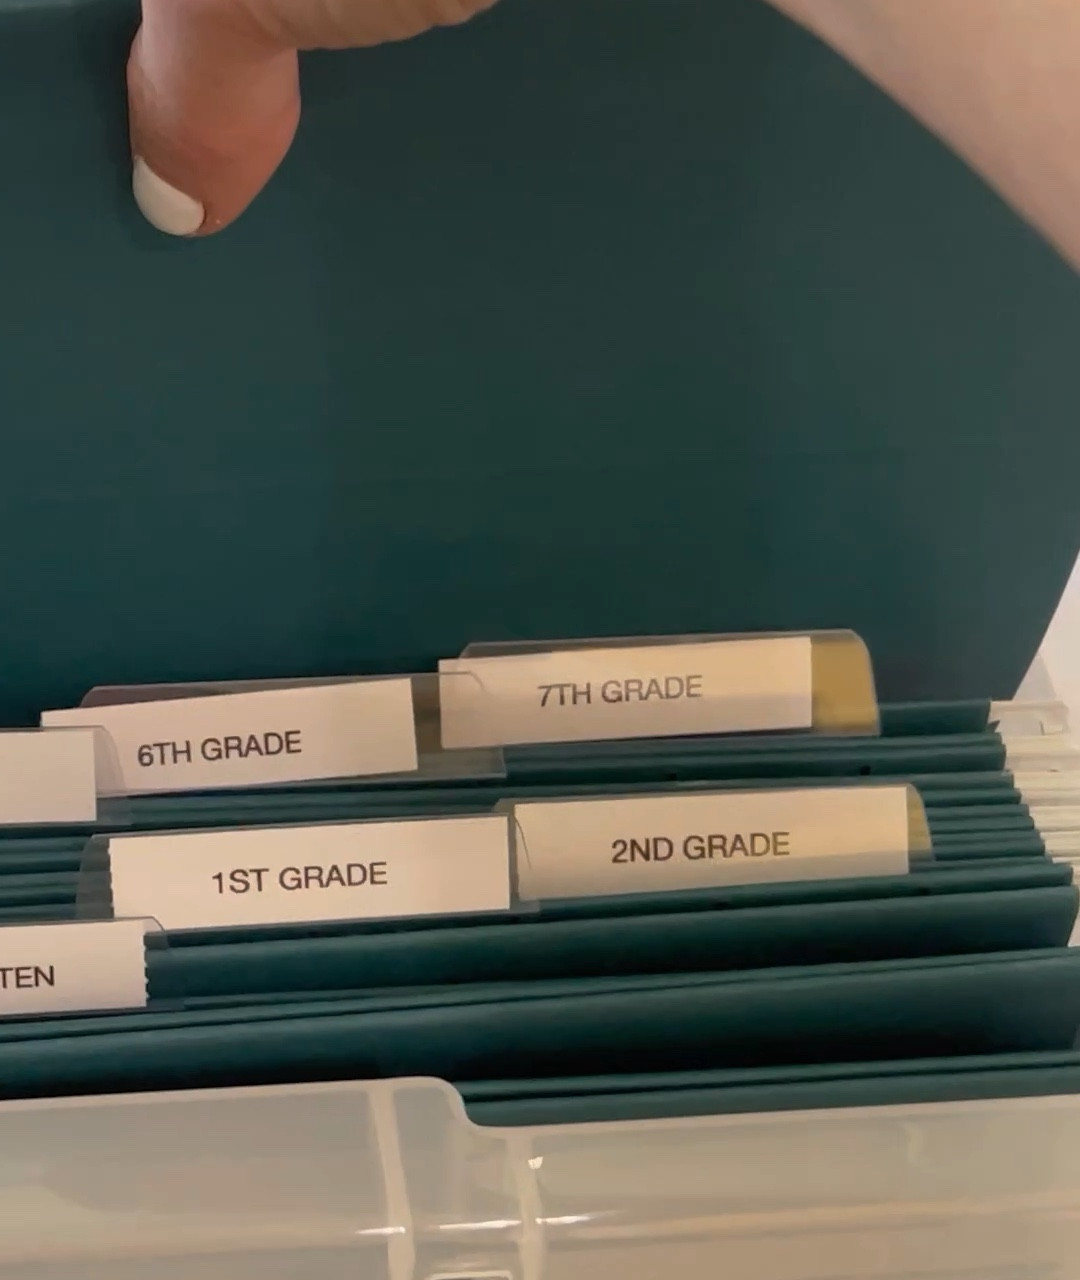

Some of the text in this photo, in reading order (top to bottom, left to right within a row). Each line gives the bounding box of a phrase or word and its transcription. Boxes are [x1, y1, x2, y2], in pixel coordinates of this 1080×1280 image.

[538, 674, 702, 708] 7TH GRADE
[137, 730, 302, 767] 6TH GRADE
[611, 831, 790, 864] 2ND GRADE
[212, 861, 388, 894] 1ST GRADE
